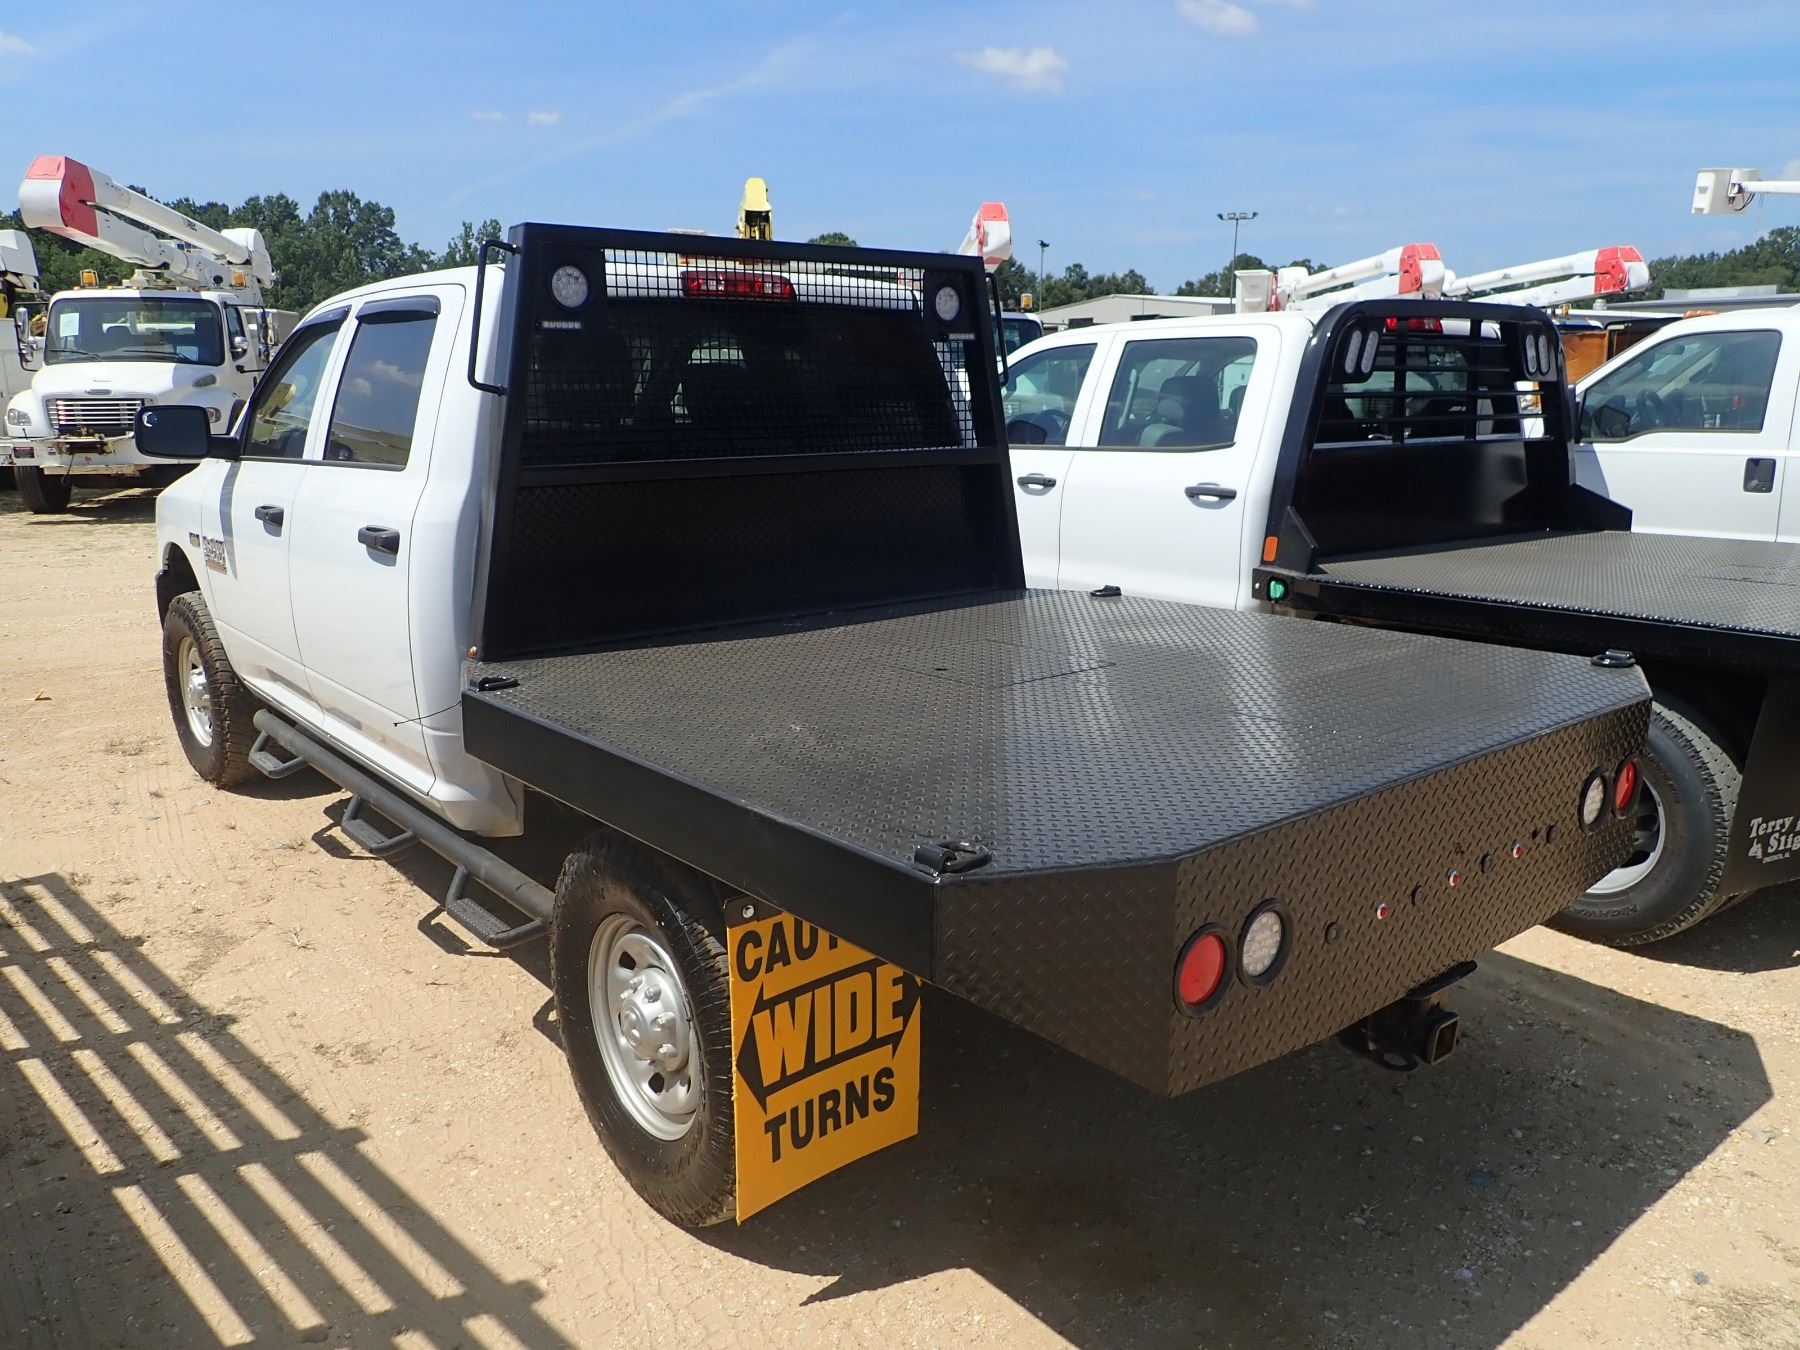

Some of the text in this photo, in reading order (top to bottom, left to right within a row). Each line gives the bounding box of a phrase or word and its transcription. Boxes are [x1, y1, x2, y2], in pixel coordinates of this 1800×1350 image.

[1749, 816, 1794, 839] Terry
[752, 964, 904, 1088] WIDE
[764, 1066, 895, 1163] TURNS
